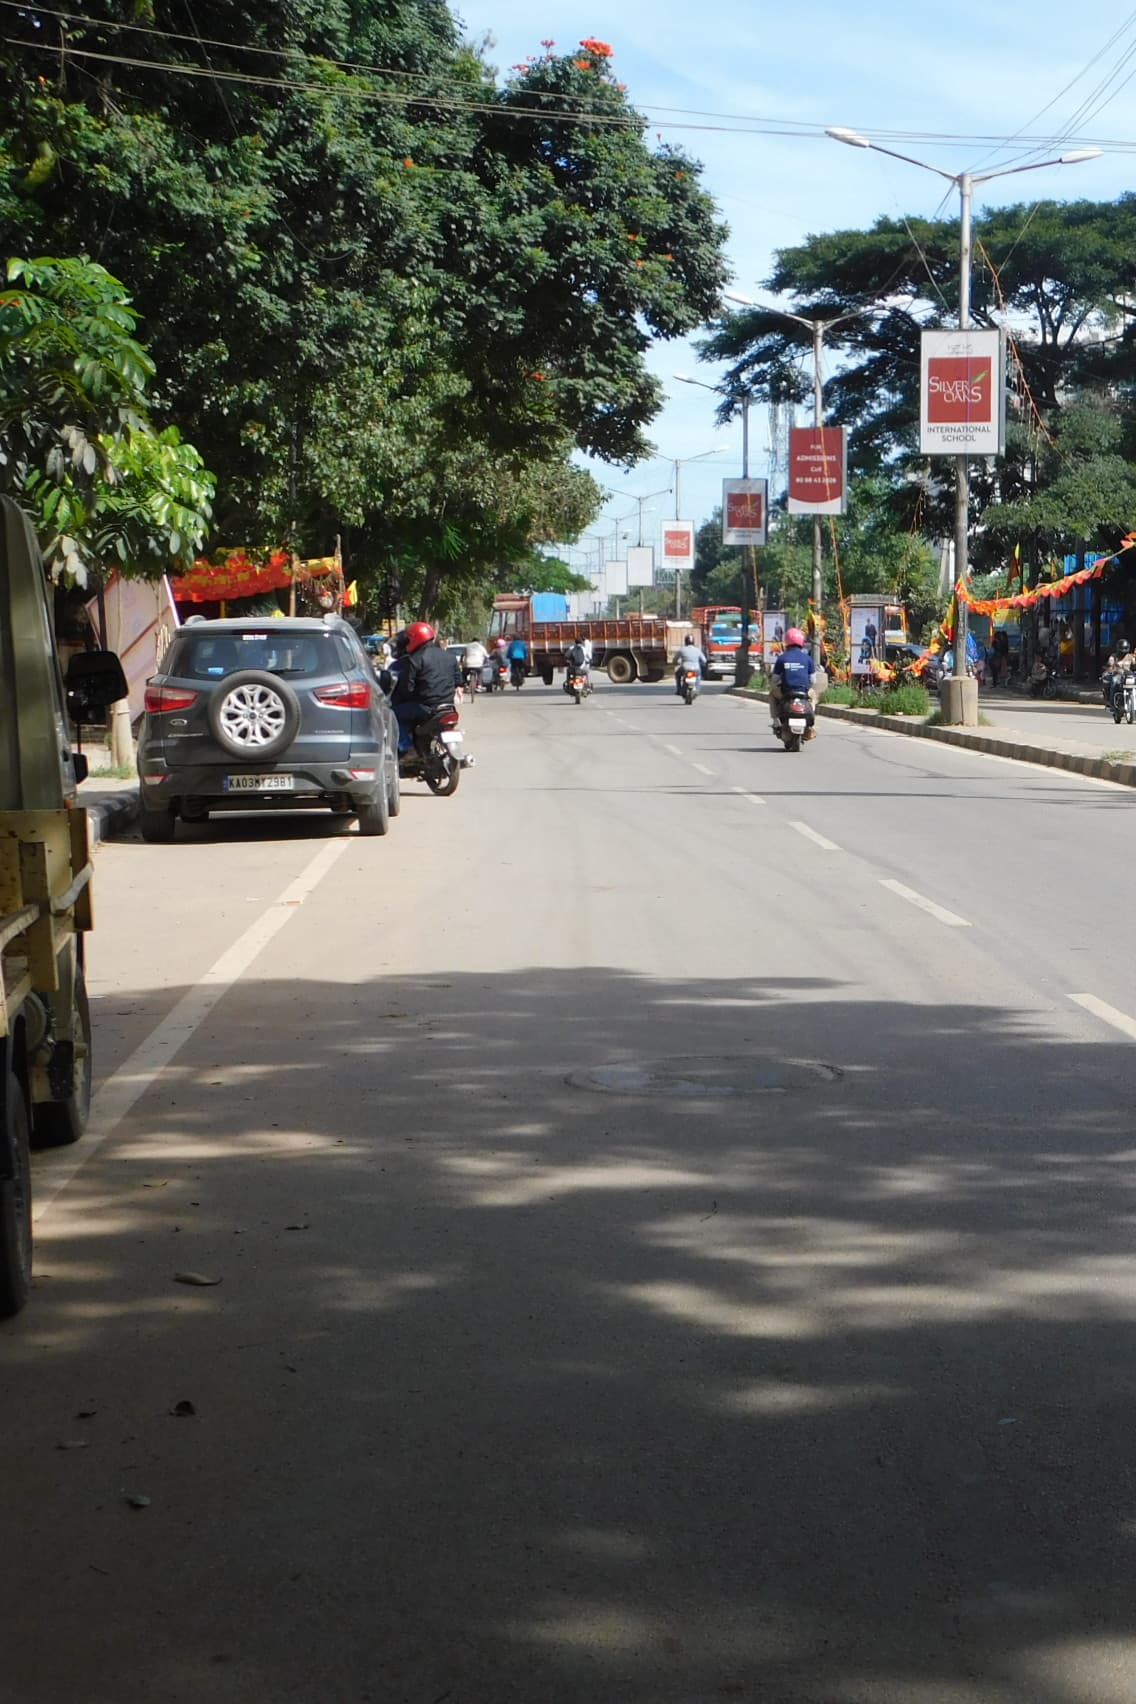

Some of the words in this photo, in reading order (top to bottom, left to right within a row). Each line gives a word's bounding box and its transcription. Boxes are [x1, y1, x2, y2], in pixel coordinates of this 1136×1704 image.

[929, 376, 970, 393] SILVER
[943, 386, 982, 403] OAKS
[927, 425, 991, 433] INTERNATIONAL
[942, 434, 976, 442] SCHOOL
